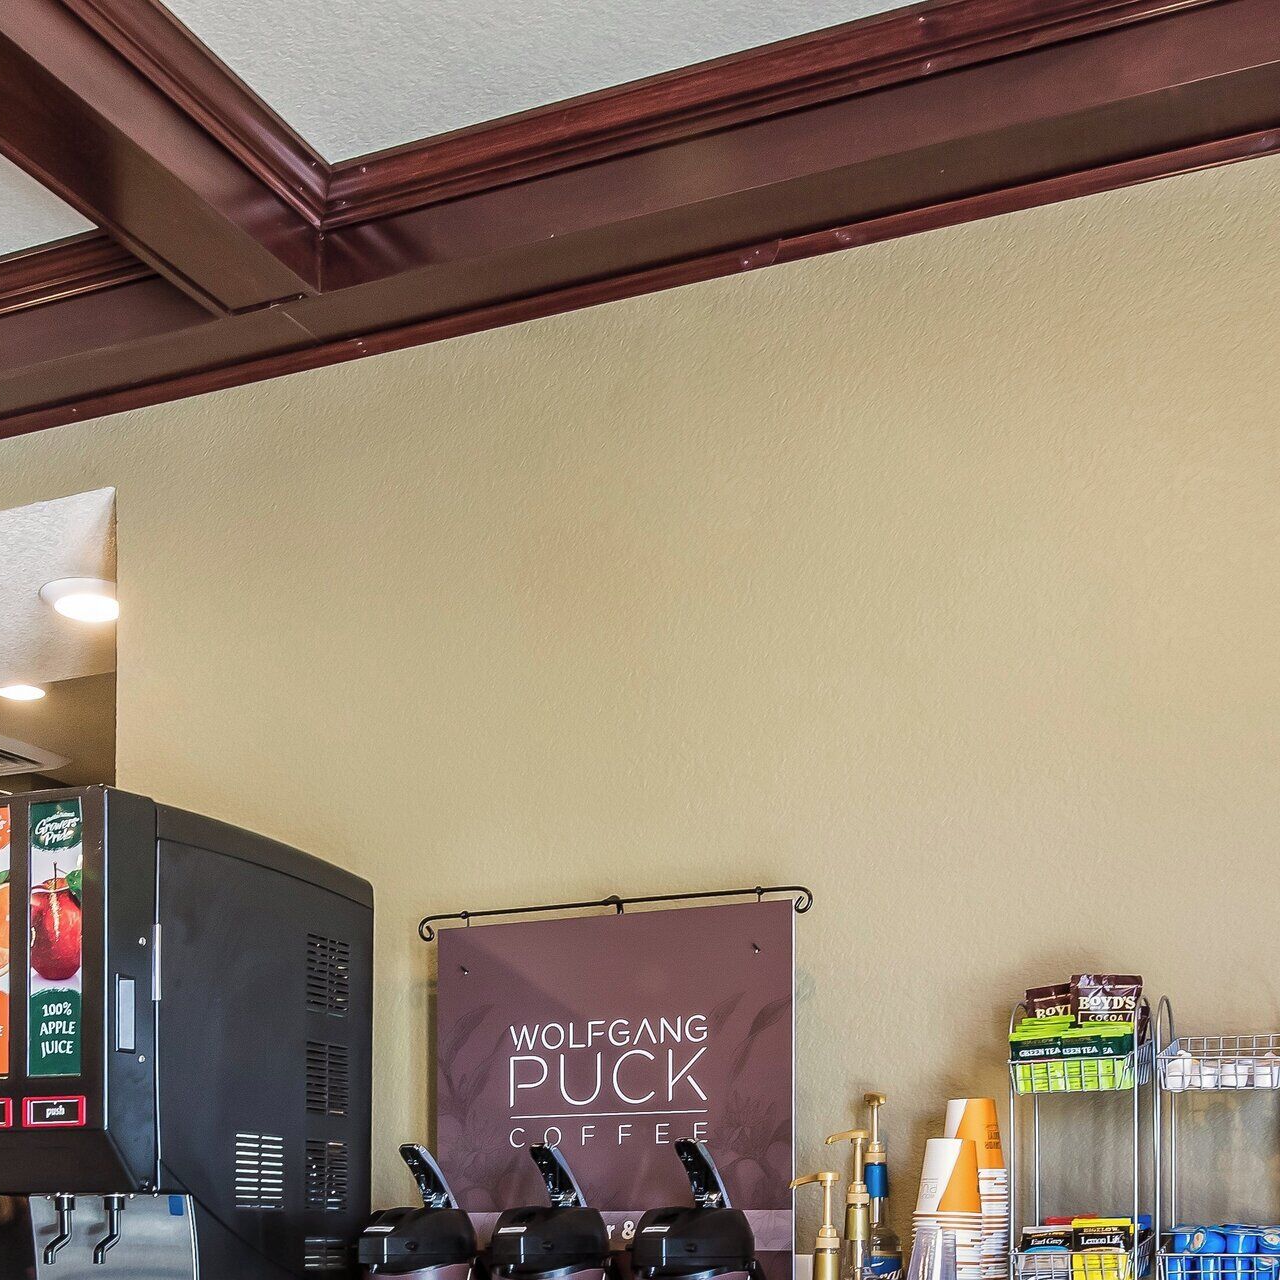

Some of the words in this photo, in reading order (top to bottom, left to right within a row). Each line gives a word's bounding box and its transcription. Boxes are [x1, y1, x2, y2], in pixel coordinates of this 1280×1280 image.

[35, 816, 80, 836] Growers
[43, 830, 73, 846] Pride
[41, 1001, 73, 1017] 100%
[1078, 996, 1137, 1011] BOYD'S
[1088, 1013, 1125, 1022] COCOA
[39, 1020, 76, 1036] APPLE
[509, 1014, 708, 1051] WOLFGANG
[41, 1040, 74, 1059] JUICE
[1045, 1046, 1061, 1055] TEA
[1081, 1045, 1099, 1055] TEA
[509, 1046, 708, 1108] PUCK
[45, 1104, 66, 1119] push
[509, 1121, 709, 1149] COFFEE
[1080, 1236, 1106, 1246] Lemon
